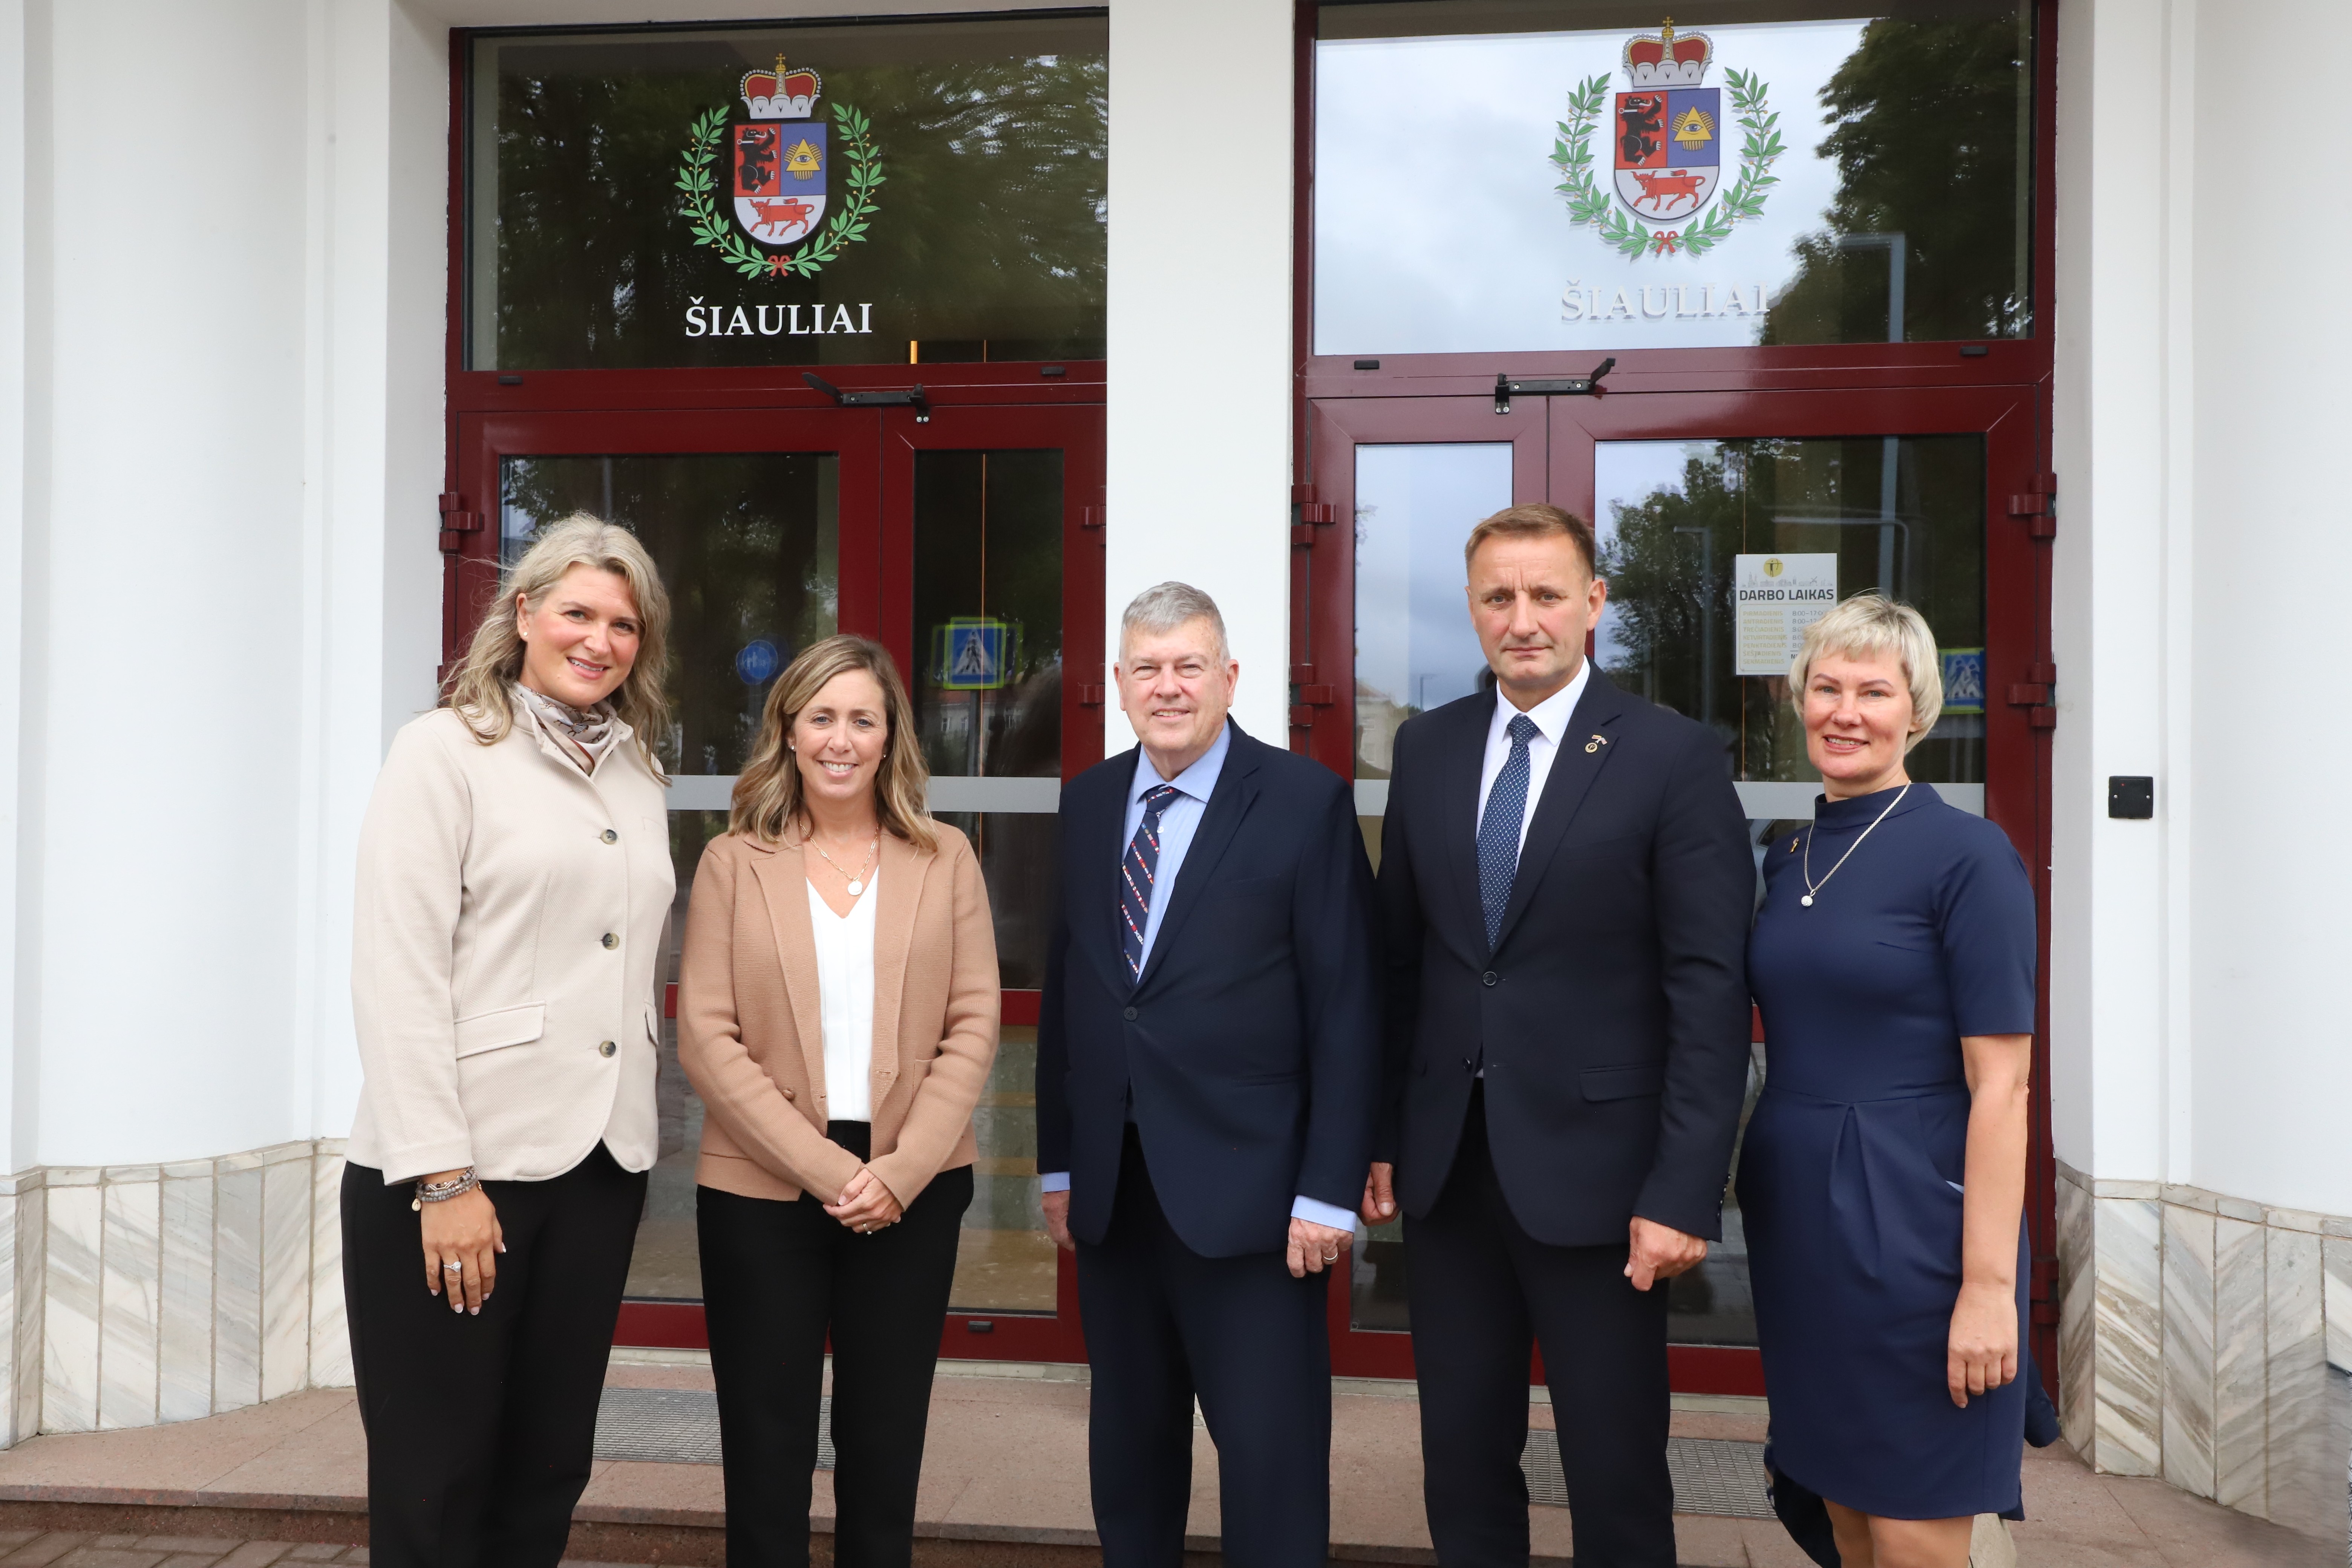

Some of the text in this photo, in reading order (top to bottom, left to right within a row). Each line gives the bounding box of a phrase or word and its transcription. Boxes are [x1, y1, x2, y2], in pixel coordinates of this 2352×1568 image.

[686, 296, 873, 337] ŠIAULIAI
[1562, 278, 1770, 318] ŠIAULIAI
[1740, 589, 1834, 600] DARBO LAIKAS
